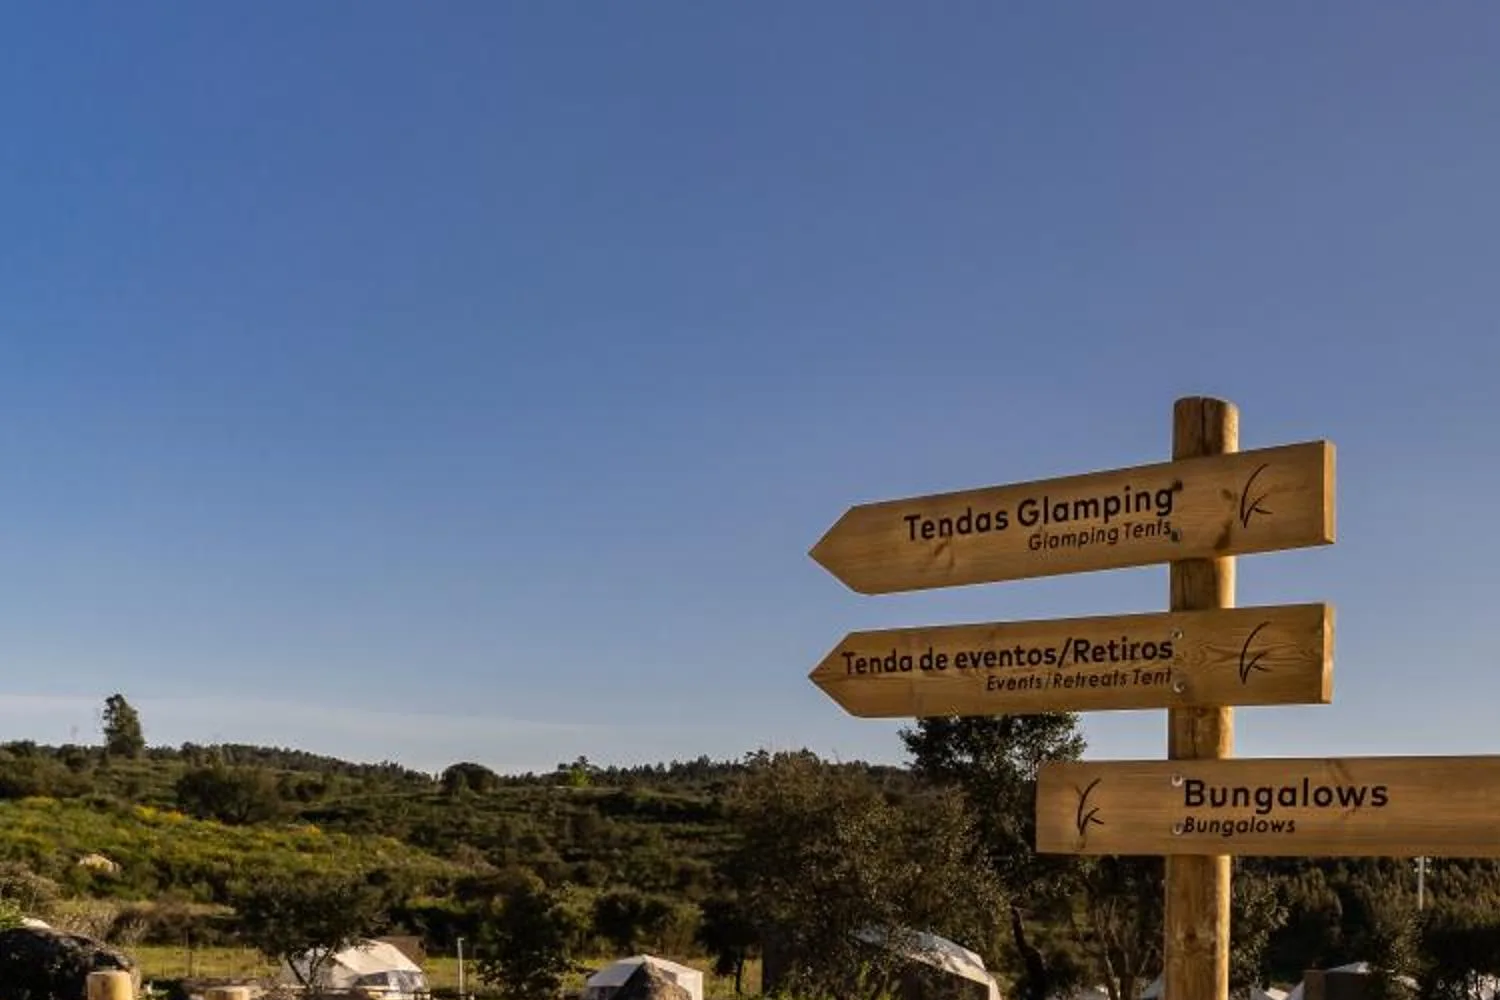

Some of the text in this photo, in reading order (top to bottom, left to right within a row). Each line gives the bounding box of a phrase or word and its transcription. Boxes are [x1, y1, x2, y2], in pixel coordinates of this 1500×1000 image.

[904, 485, 1174, 541] Tendas Glamping
[1028, 518, 1172, 551] Glamping Tents
[842, 636, 1174, 675] Tenda de eventos/Retiros
[1132, 665, 1173, 686] Tent
[1184, 776, 1390, 815] Bungalows
[1183, 816, 1296, 838] Bungalows
